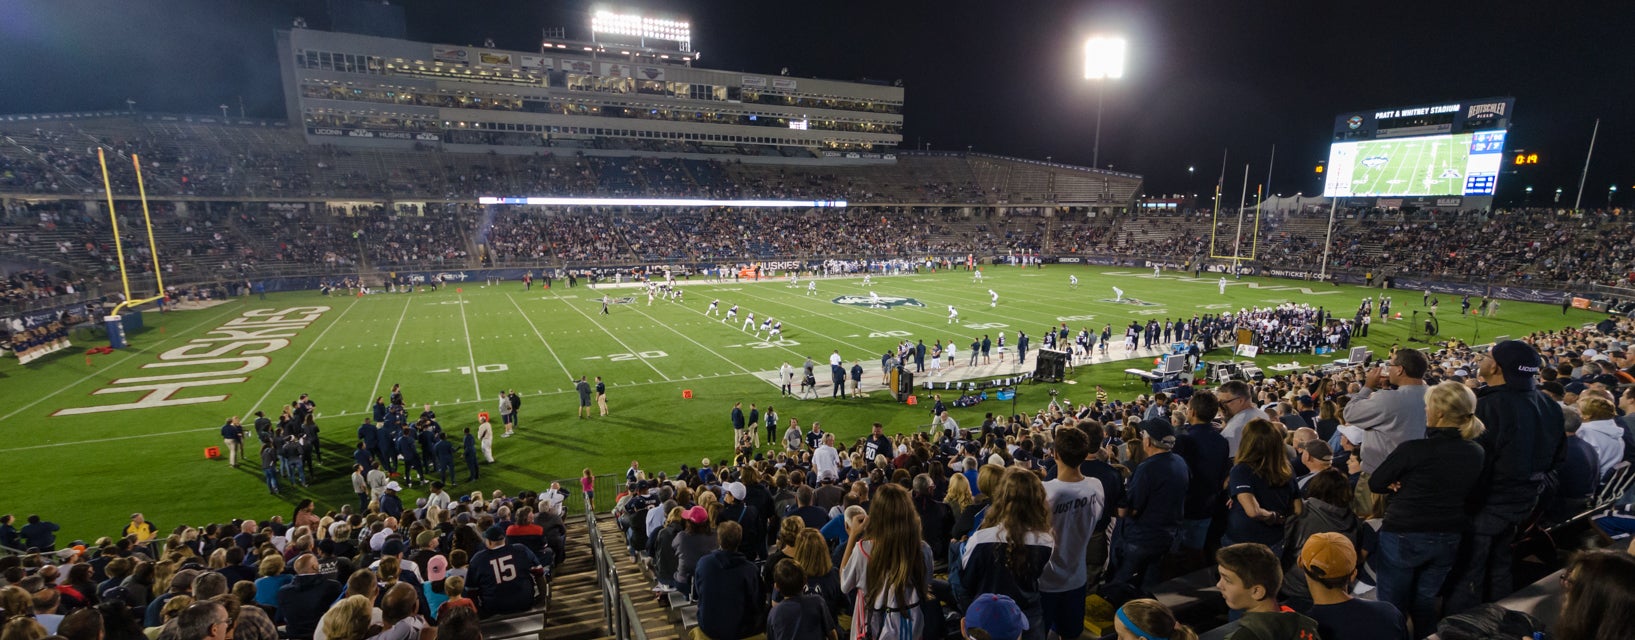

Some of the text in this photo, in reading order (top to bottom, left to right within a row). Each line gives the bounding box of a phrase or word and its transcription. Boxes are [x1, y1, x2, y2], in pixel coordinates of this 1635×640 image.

[1375, 104, 1460, 119] PRATT & WHITNEY STADIUM
[315, 128, 342, 136] UCONN
[379, 131, 411, 140] HUSKIES
[1515, 154, 1538, 165] 0:19
[50, 305, 331, 417] HUSKIES
[606, 350, 669, 362] 20
[456, 363, 509, 375] 10
[865, 447, 876, 460] 80
[1053, 499, 1074, 514] JUST
[1074, 496, 1088, 509] DO
[489, 554, 517, 585] 15
